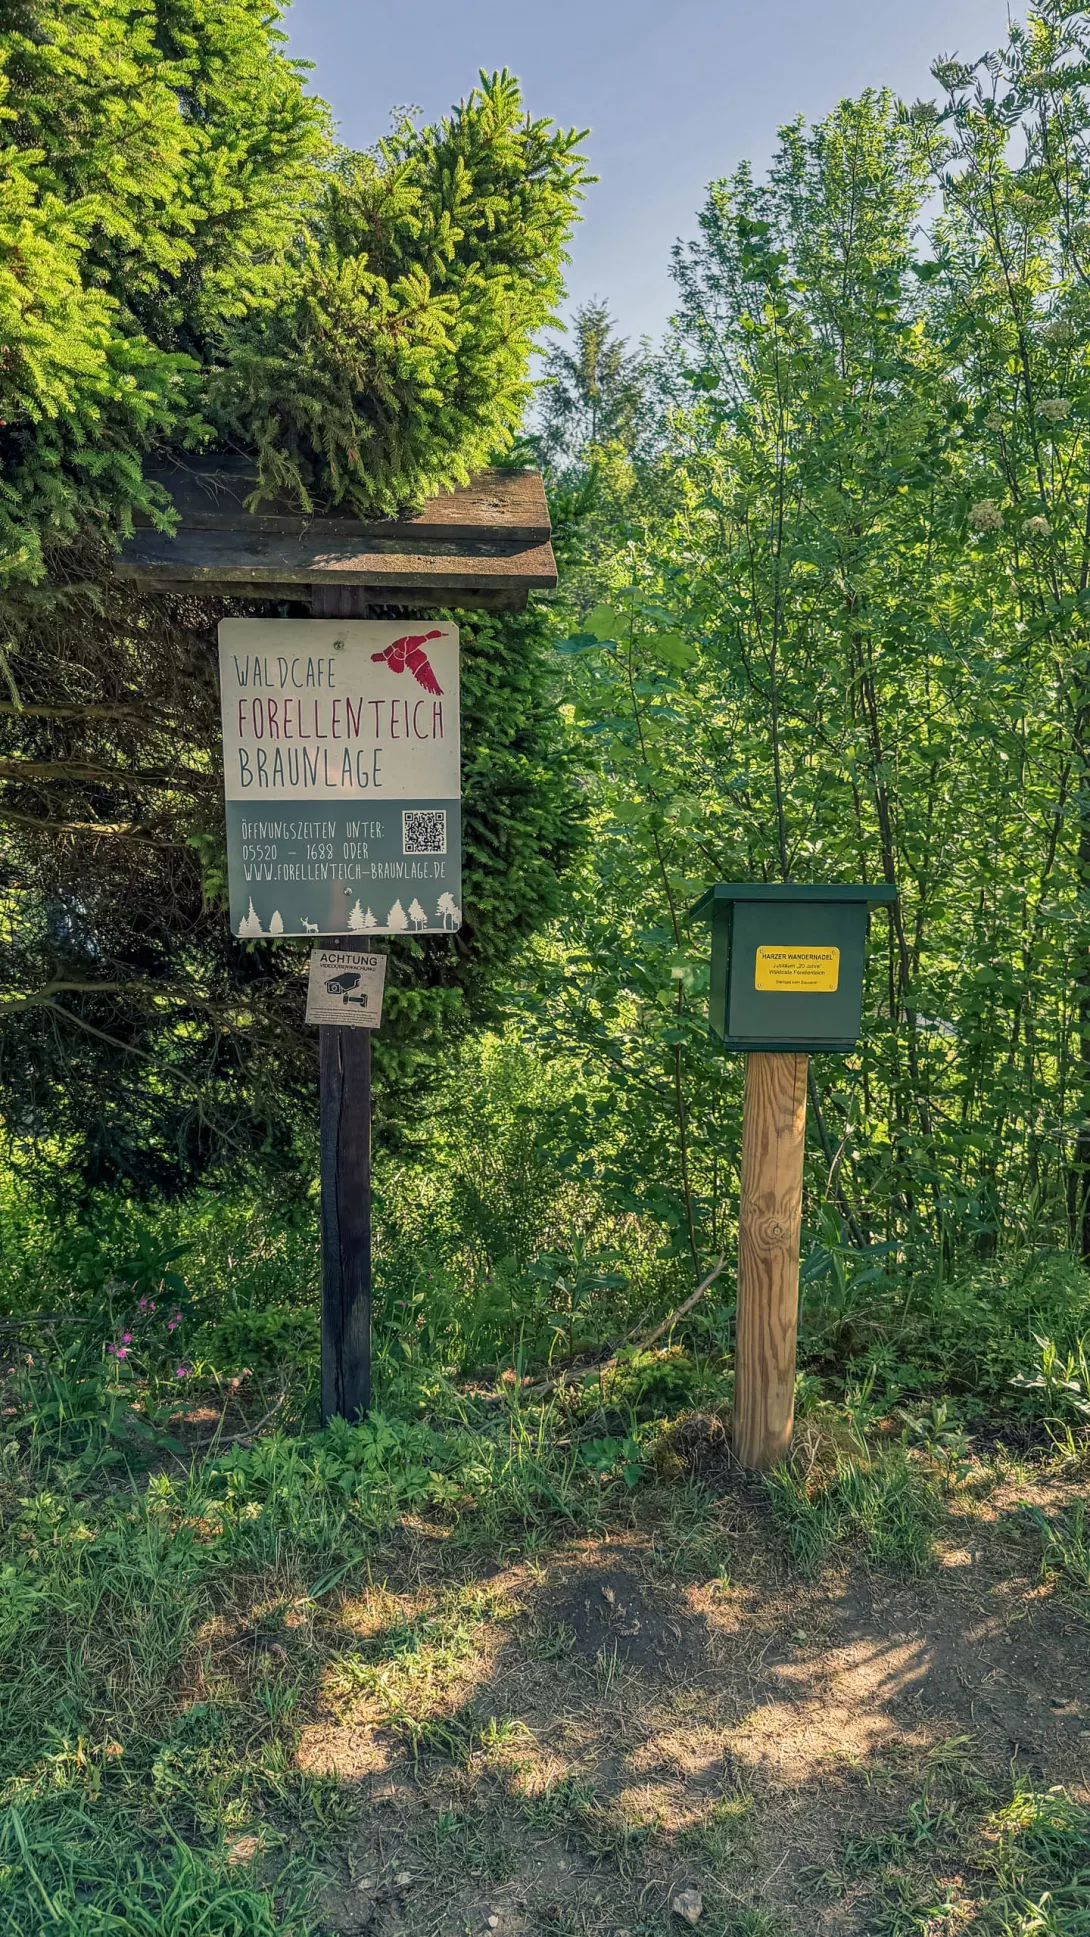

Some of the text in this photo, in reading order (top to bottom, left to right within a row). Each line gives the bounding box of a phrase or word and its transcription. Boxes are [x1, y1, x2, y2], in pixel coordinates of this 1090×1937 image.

[234, 655, 335, 688] WALDCAFE
[238, 697, 443, 739] FORELLENTEICH
[239, 746, 382, 788] BRAUNLAGE
[241, 818, 385, 840] ÖFFNUNGSZEITEN UNTER:
[242, 844, 277, 861] 05520
[307, 843, 333, 860] 1688
[343, 842, 369, 860] ODER
[243, 862, 446, 881] WWW.FORELLENTEICH-BRAUNLAGE.DE
[320, 953, 378, 967] ACHTUNG
[788, 953, 833, 961] WANDERNADEL
